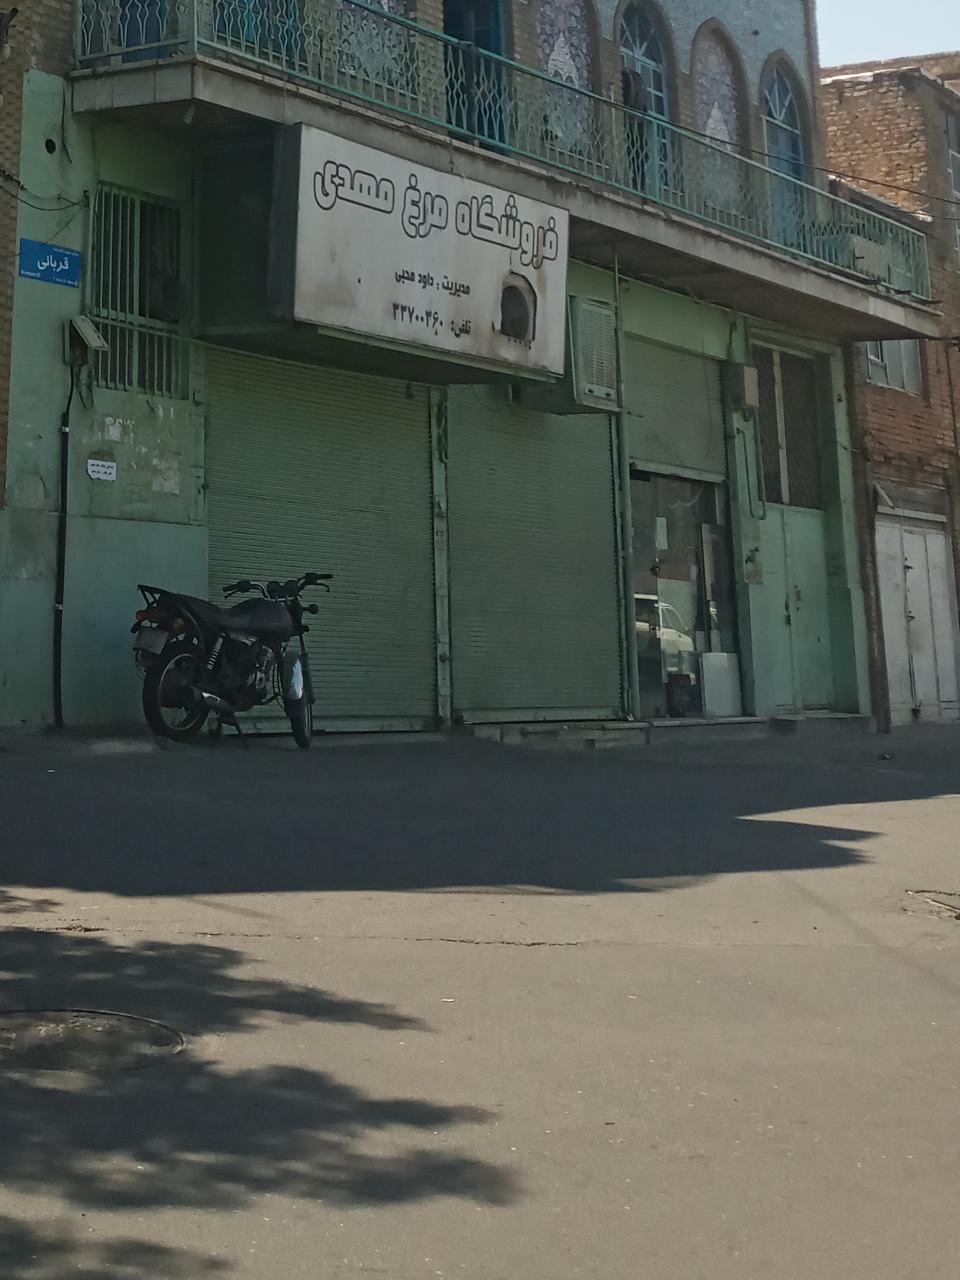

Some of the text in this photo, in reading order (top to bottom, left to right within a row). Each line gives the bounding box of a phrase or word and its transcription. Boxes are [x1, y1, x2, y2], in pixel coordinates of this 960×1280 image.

[313, 160, 558, 269] فروشگاه مرغ مهدی
[418, 272, 434, 289] داود
